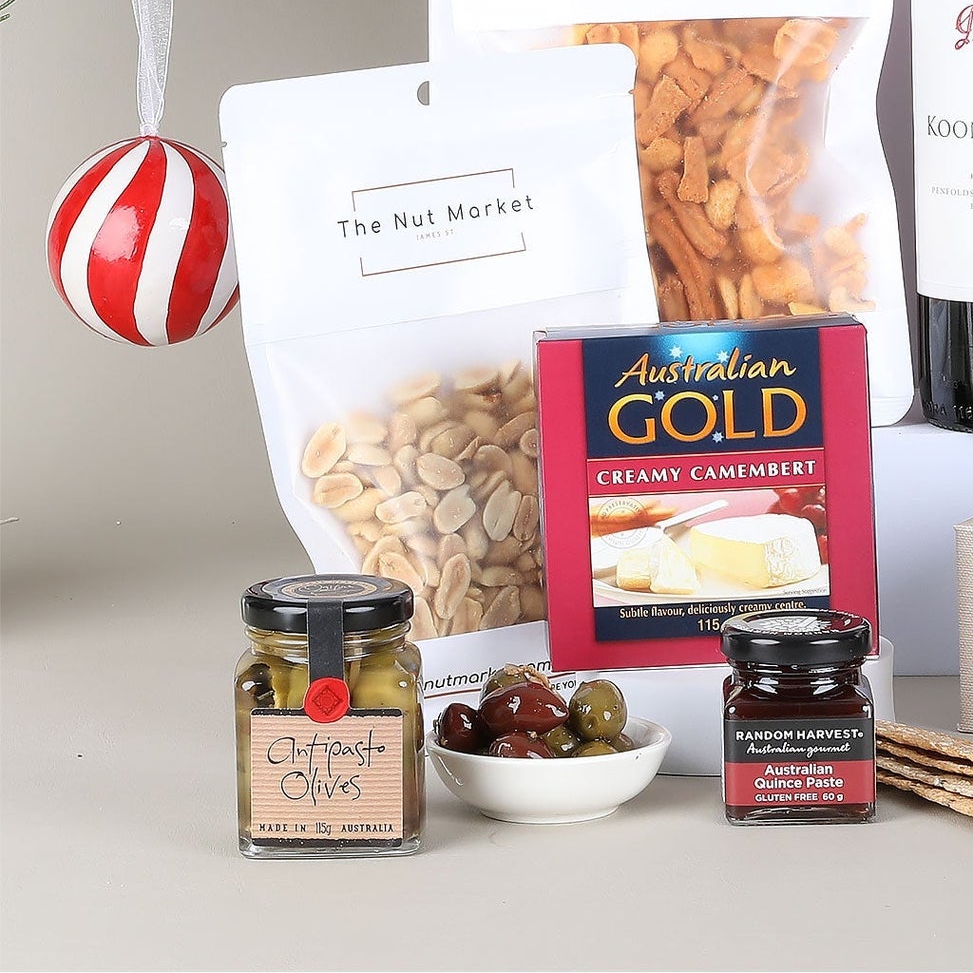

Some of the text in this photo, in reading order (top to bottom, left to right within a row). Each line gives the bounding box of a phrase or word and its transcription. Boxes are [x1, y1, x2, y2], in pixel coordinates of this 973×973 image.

[337, 195, 534, 238] The Nut Market
[416, 231, 441, 241] JAMES
[614, 347, 797, 388] Australian
[607, 387, 808, 445] GOLD
[597, 460, 817, 486] CREAMY CAMEMBERT
[619, 607, 649, 619] Subtle
[651, 605, 685, 618] flavour,
[687, 603, 736, 616] deliciously
[774, 600, 806, 609] centre.
[736, 731, 793, 741] RANDOM
[746, 742, 851, 758] Australian gourmet
[764, 763, 833, 776] Australian
[280, 767, 361, 806] Olives
[754, 777, 844, 790] Quince Paste
[755, 793, 844, 802] GLUTEN FREE 60 g
[259, 822, 394, 836] MADE IN 115g AUSTRALIA
